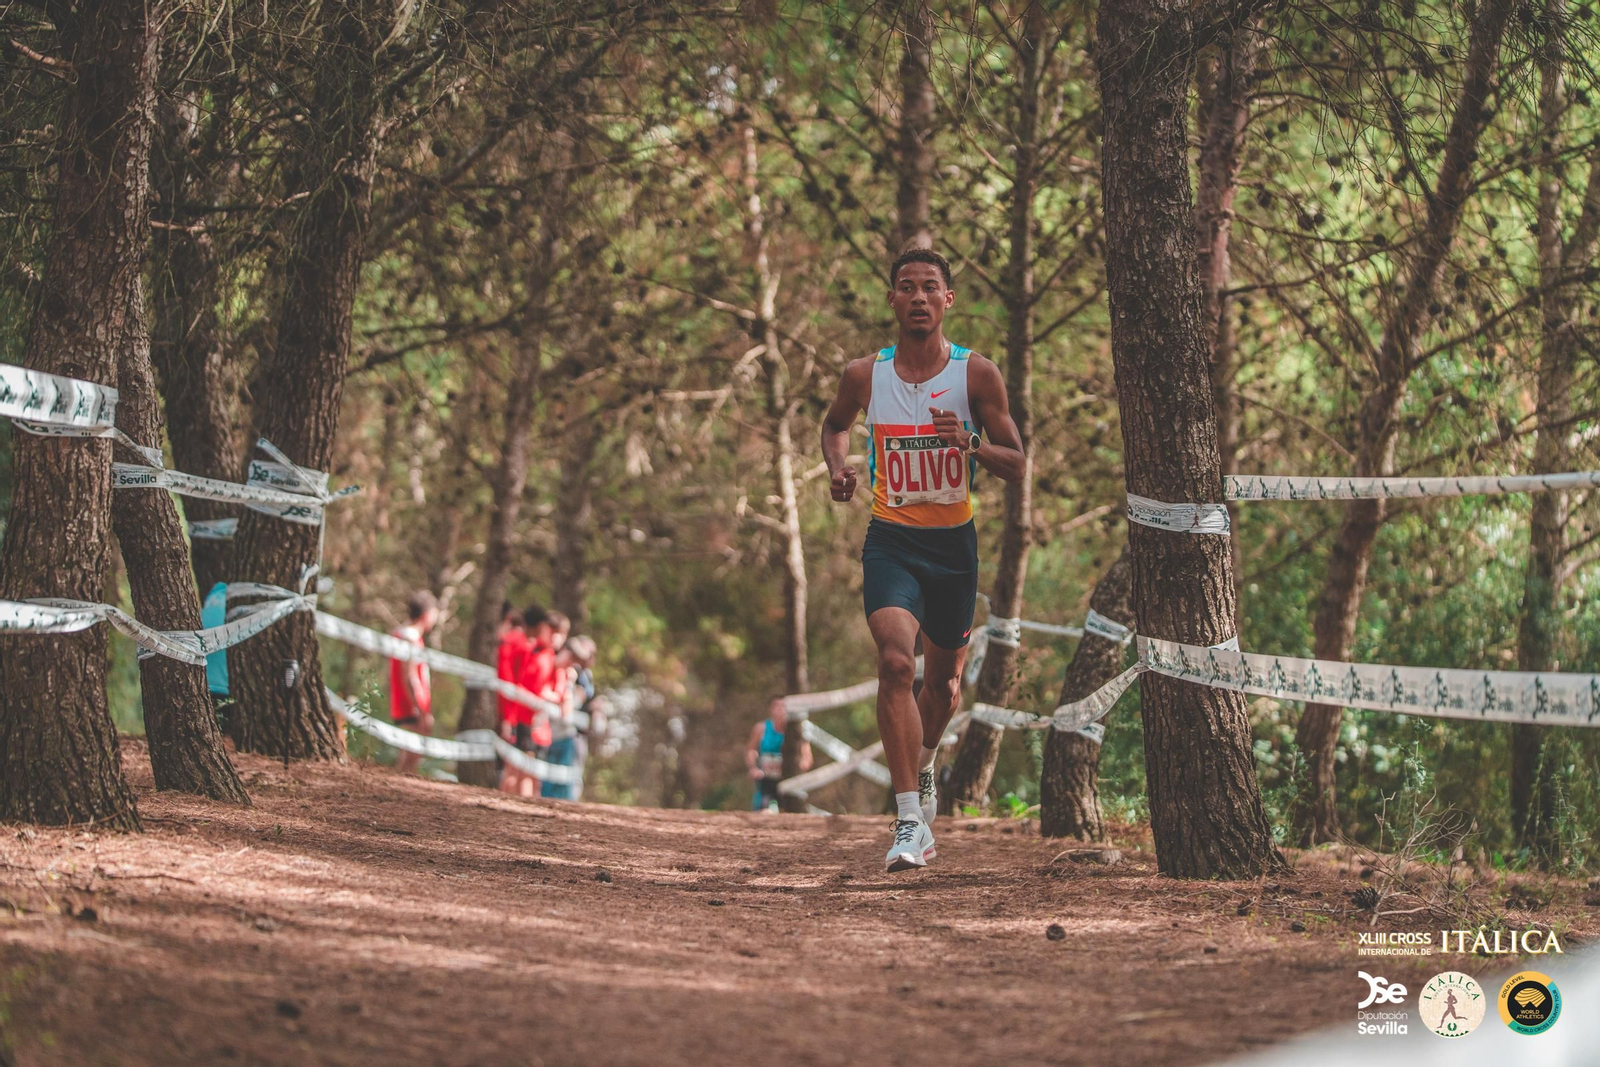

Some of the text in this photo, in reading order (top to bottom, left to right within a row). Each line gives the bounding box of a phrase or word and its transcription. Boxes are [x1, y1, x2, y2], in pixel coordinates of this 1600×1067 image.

[905, 438, 941, 448] ITÁLICA
[888, 448, 962, 492] OLIVO
[119, 474, 157, 485] Sevilla
